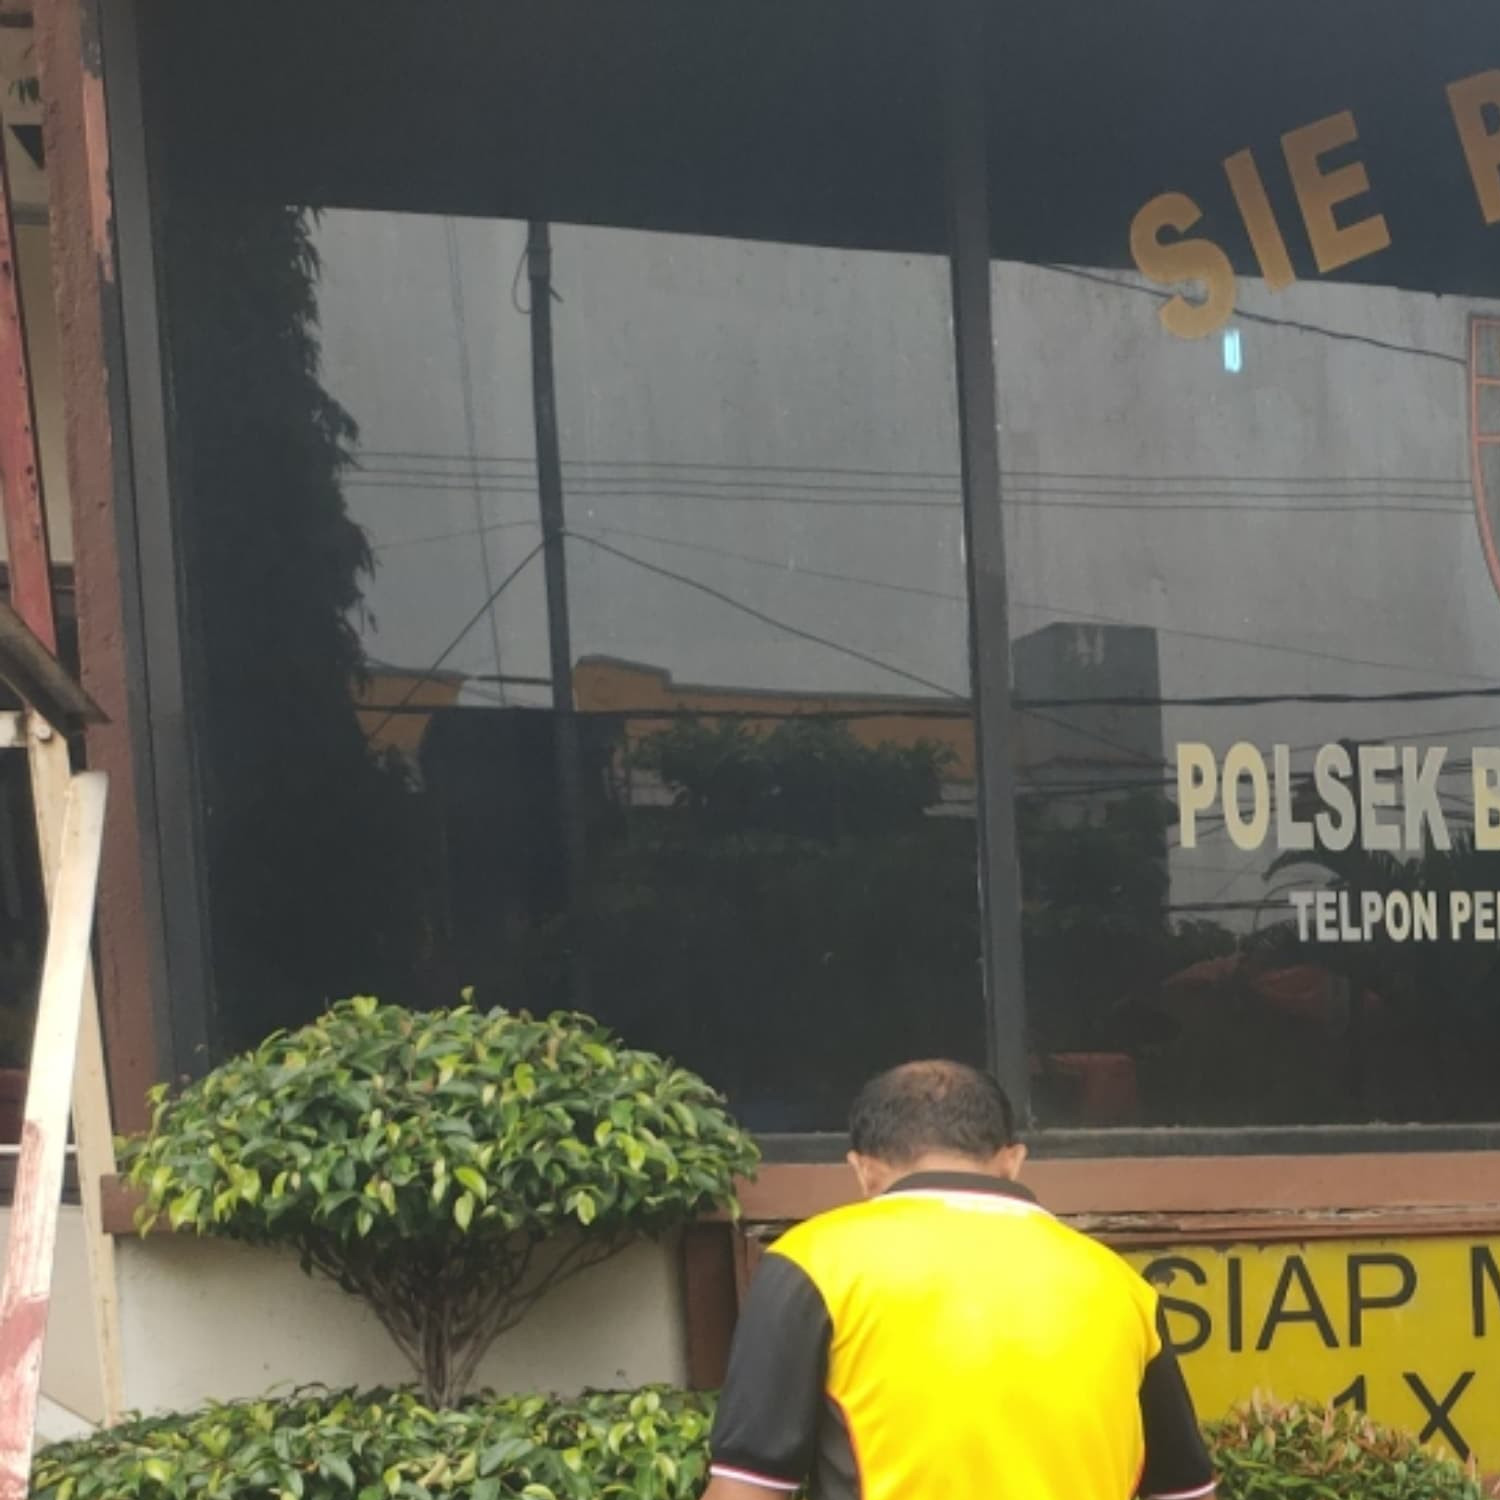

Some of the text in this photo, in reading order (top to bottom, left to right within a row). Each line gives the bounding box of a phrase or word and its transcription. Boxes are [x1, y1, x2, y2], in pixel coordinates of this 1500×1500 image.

[1129, 109, 1391, 339] SIE
[1175, 742, 1451, 853] POLSEK
[1289, 889, 1438, 943] TELPON
[1157, 1252, 1418, 1356] SIAP
[1402, 1370, 1478, 1465] X
